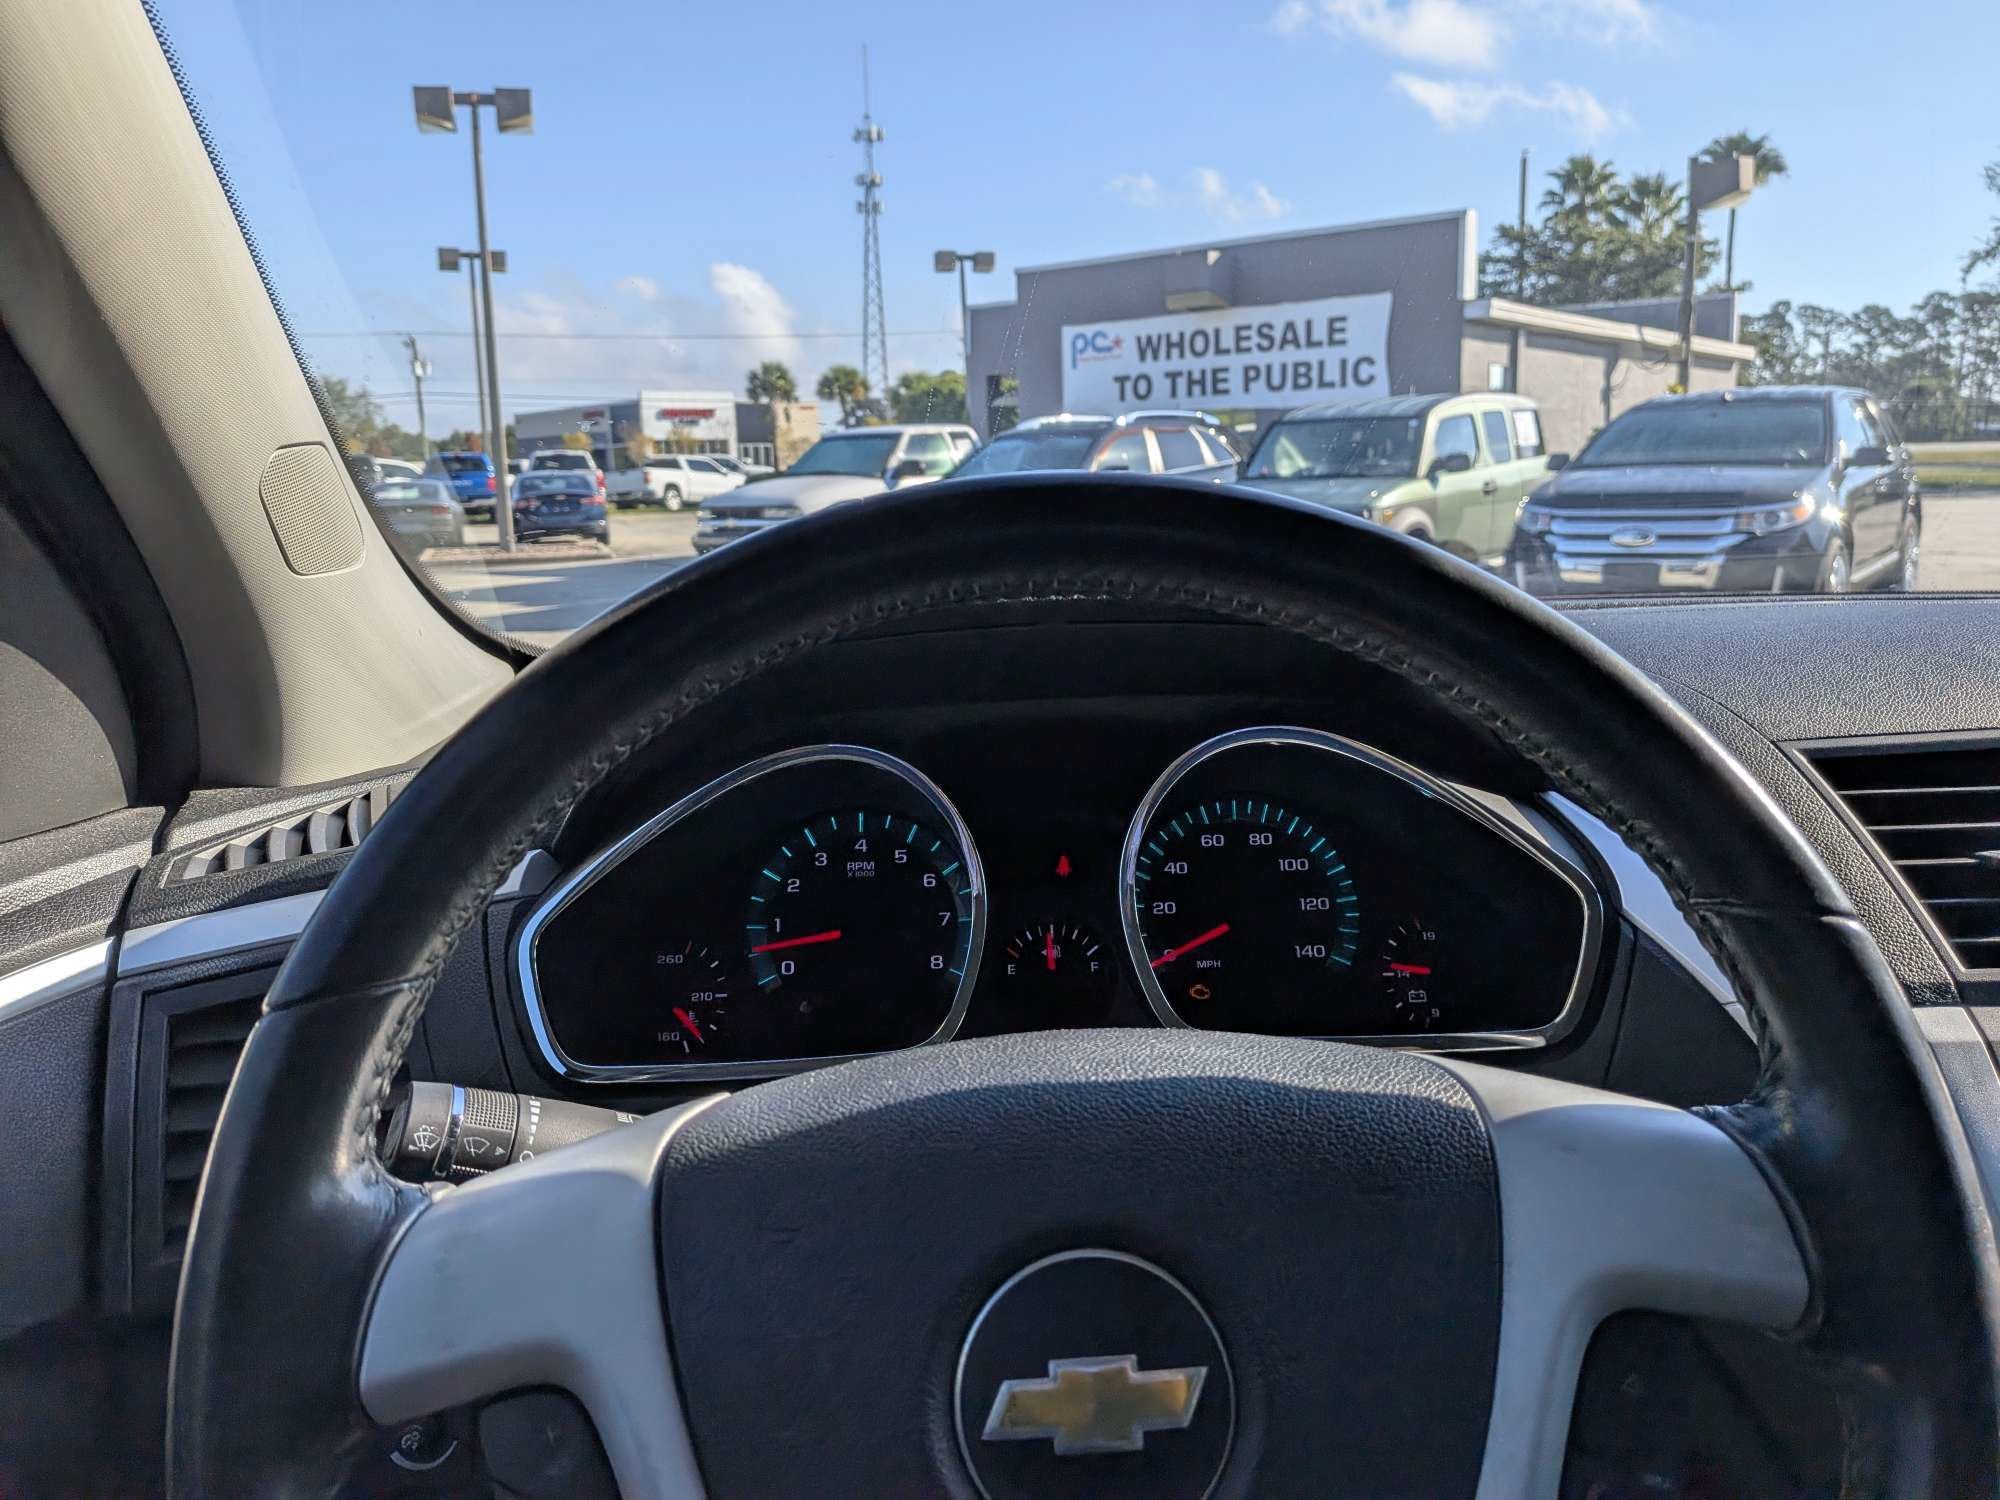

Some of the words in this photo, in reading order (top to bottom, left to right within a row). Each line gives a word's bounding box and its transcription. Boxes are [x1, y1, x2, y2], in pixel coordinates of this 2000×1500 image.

[1137, 316, 1348, 363] WHOLESALE
[1113, 373, 1154, 402] TO
[1165, 367, 1230, 398] THE
[1244, 356, 1377, 394] PUBLIC
[855, 839, 868, 852] 4
[1201, 835, 1225, 847] 60
[1249, 833, 1273, 846] 80
[815, 852, 828, 866] 3
[894, 849, 908, 864] 5
[847, 861, 875, 870] RPM
[1164, 862, 1188, 875] 40
[1278, 858, 1309, 872] 100
[787, 878, 800, 892] 2
[923, 874, 936, 887] 6
[1152, 902, 1176, 914] 20
[1300, 897, 1330, 911] 120
[774, 918, 782, 933] 1
[938, 912, 950, 926] 7
[1294, 945, 1326, 958] 140
[657, 954, 683, 964] 260
[930, 956, 944, 969] 8
[1196, 960, 1221, 968] MPH
[781, 961, 795, 975] 0
[1007, 964, 1016, 975] E
[1090, 962, 1099, 972] F
[691, 992, 713, 1001] 210
[1431, 1008, 1440, 1017] 9
[657, 1032, 680, 1041] 160
